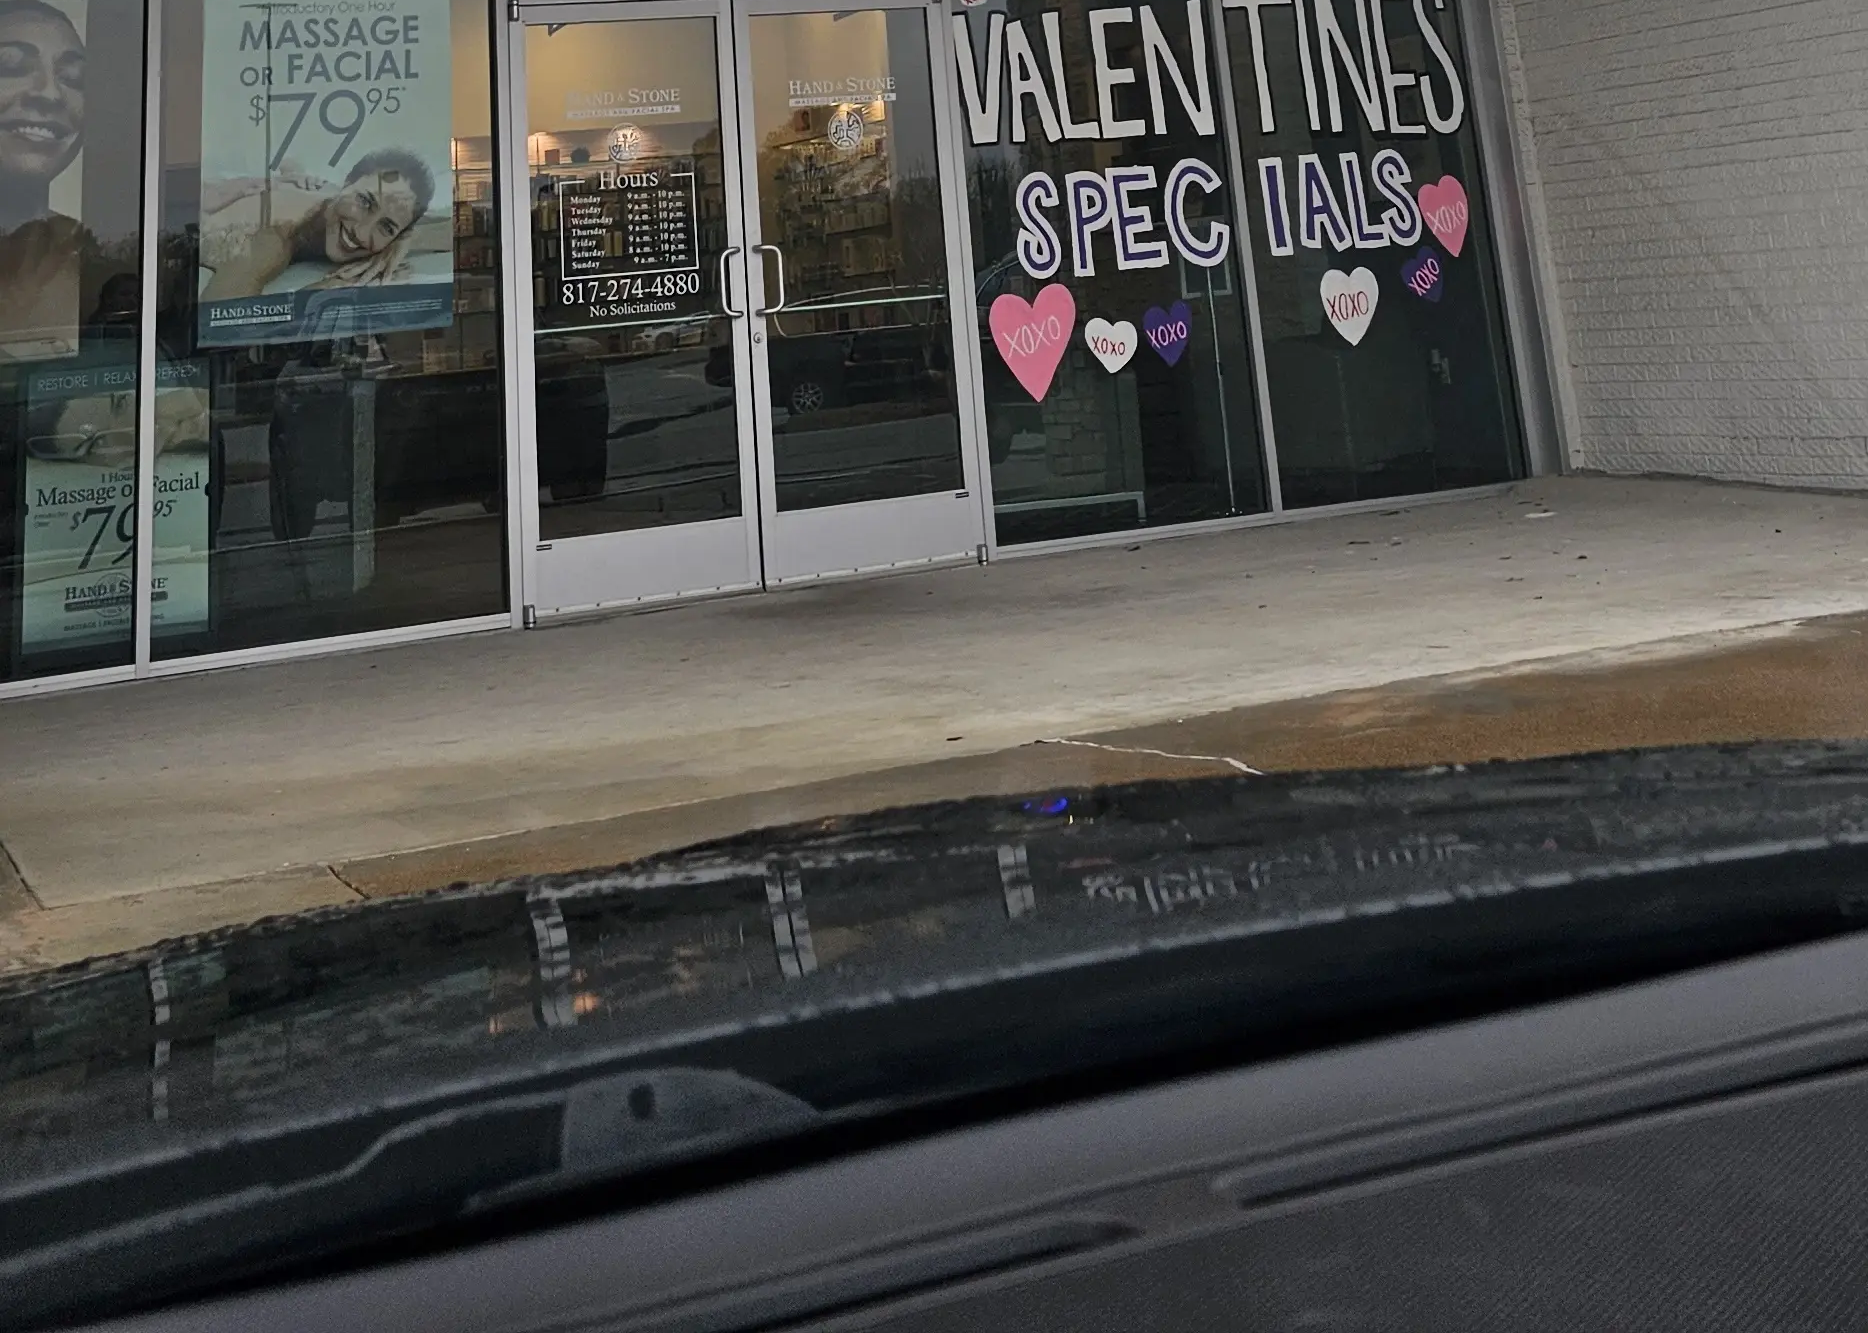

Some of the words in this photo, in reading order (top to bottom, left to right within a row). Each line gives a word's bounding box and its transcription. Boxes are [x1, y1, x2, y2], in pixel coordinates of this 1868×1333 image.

[338, 1, 364, 12] One
[368, 0, 396, 11] Hour
[239, 15, 419, 51] MASSAGE
[240, 67, 272, 87] OR
[288, 49, 419, 84] FACIAL
[789, 80, 833, 95] HAND
[846, 77, 896, 92] STONE
[628, 88, 680, 103] STONE
[599, 170, 659, 190] Hours
[570, 196, 601, 204] Monday
[571, 207, 601, 216] Tuesday
[571, 217, 613, 226] Wednesday
[659, 211, 668, 219] 10
[1427, 201, 1466, 234] XOXO
[571, 228, 606, 237] Thursday
[571, 239, 597, 248] Friday
[572, 249, 606, 258] Saturday
[661, 243, 669, 251] 10
[572, 260, 600, 269] Sunday
[1408, 258, 1439, 296] XOXO
[562, 273, 700, 305] 817-274-4880
[211, 307, 245, 319] HAND
[252, 304, 292, 315] STONE
[590, 305, 607, 317] No
[609, 300, 676, 316] Solicitations
[1326, 291, 1369, 322] XOXO
[1003, 315, 1060, 358] XOXO
[1147, 321, 1187, 349] XOXO
[1092, 335, 1126, 356] XOXO
[38, 375, 88, 391] RESTORE
[36, 484, 116, 507] Massage
[64, 584, 107, 601] HAND
